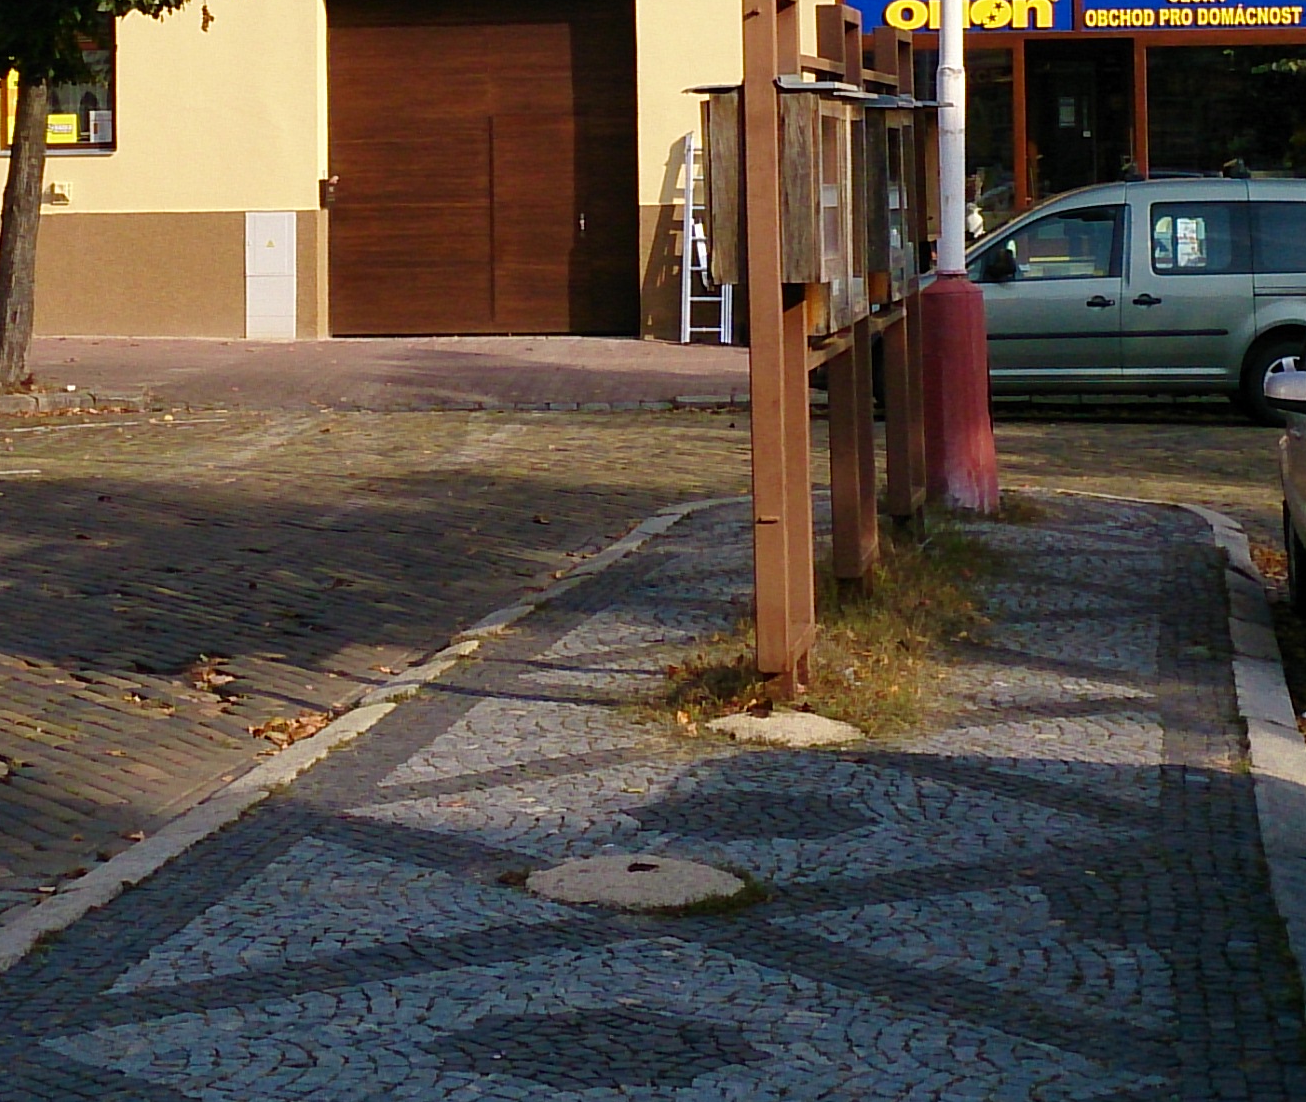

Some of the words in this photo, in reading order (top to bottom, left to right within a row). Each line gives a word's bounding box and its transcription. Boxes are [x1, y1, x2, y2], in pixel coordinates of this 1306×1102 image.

[1084, 8, 1155, 27] OBCHOD
[1158, 8, 1193, 26] PRO
[1196, 3, 1303, 26] DOMÁCNOST
